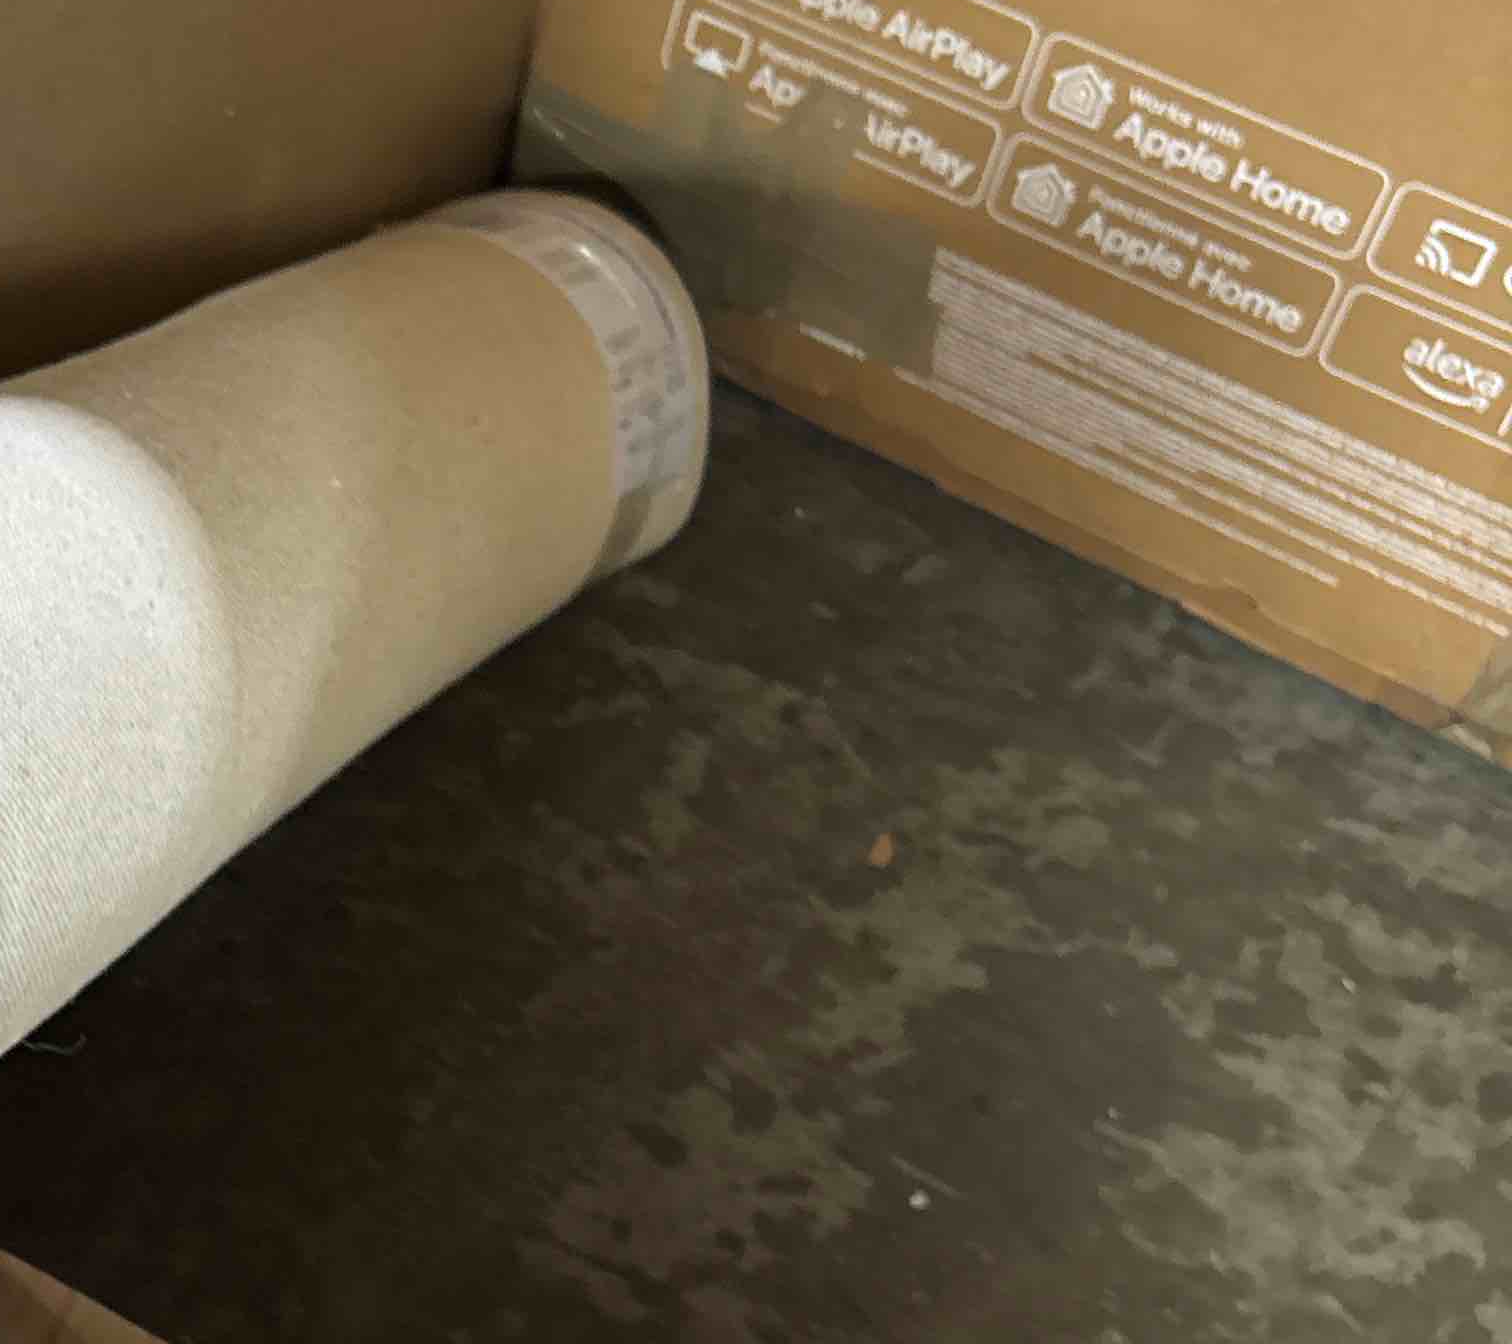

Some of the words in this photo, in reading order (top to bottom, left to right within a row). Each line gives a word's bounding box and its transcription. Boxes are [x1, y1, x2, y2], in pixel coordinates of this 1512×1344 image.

[881, 8, 1012, 92] AirPlay
[1112, 111, 1228, 184] Apple
[1228, 157, 1352, 237] Home
[1075, 210, 1185, 281] Apple
[1188, 256, 1304, 335] Home
[1402, 336, 1505, 399] alexa
